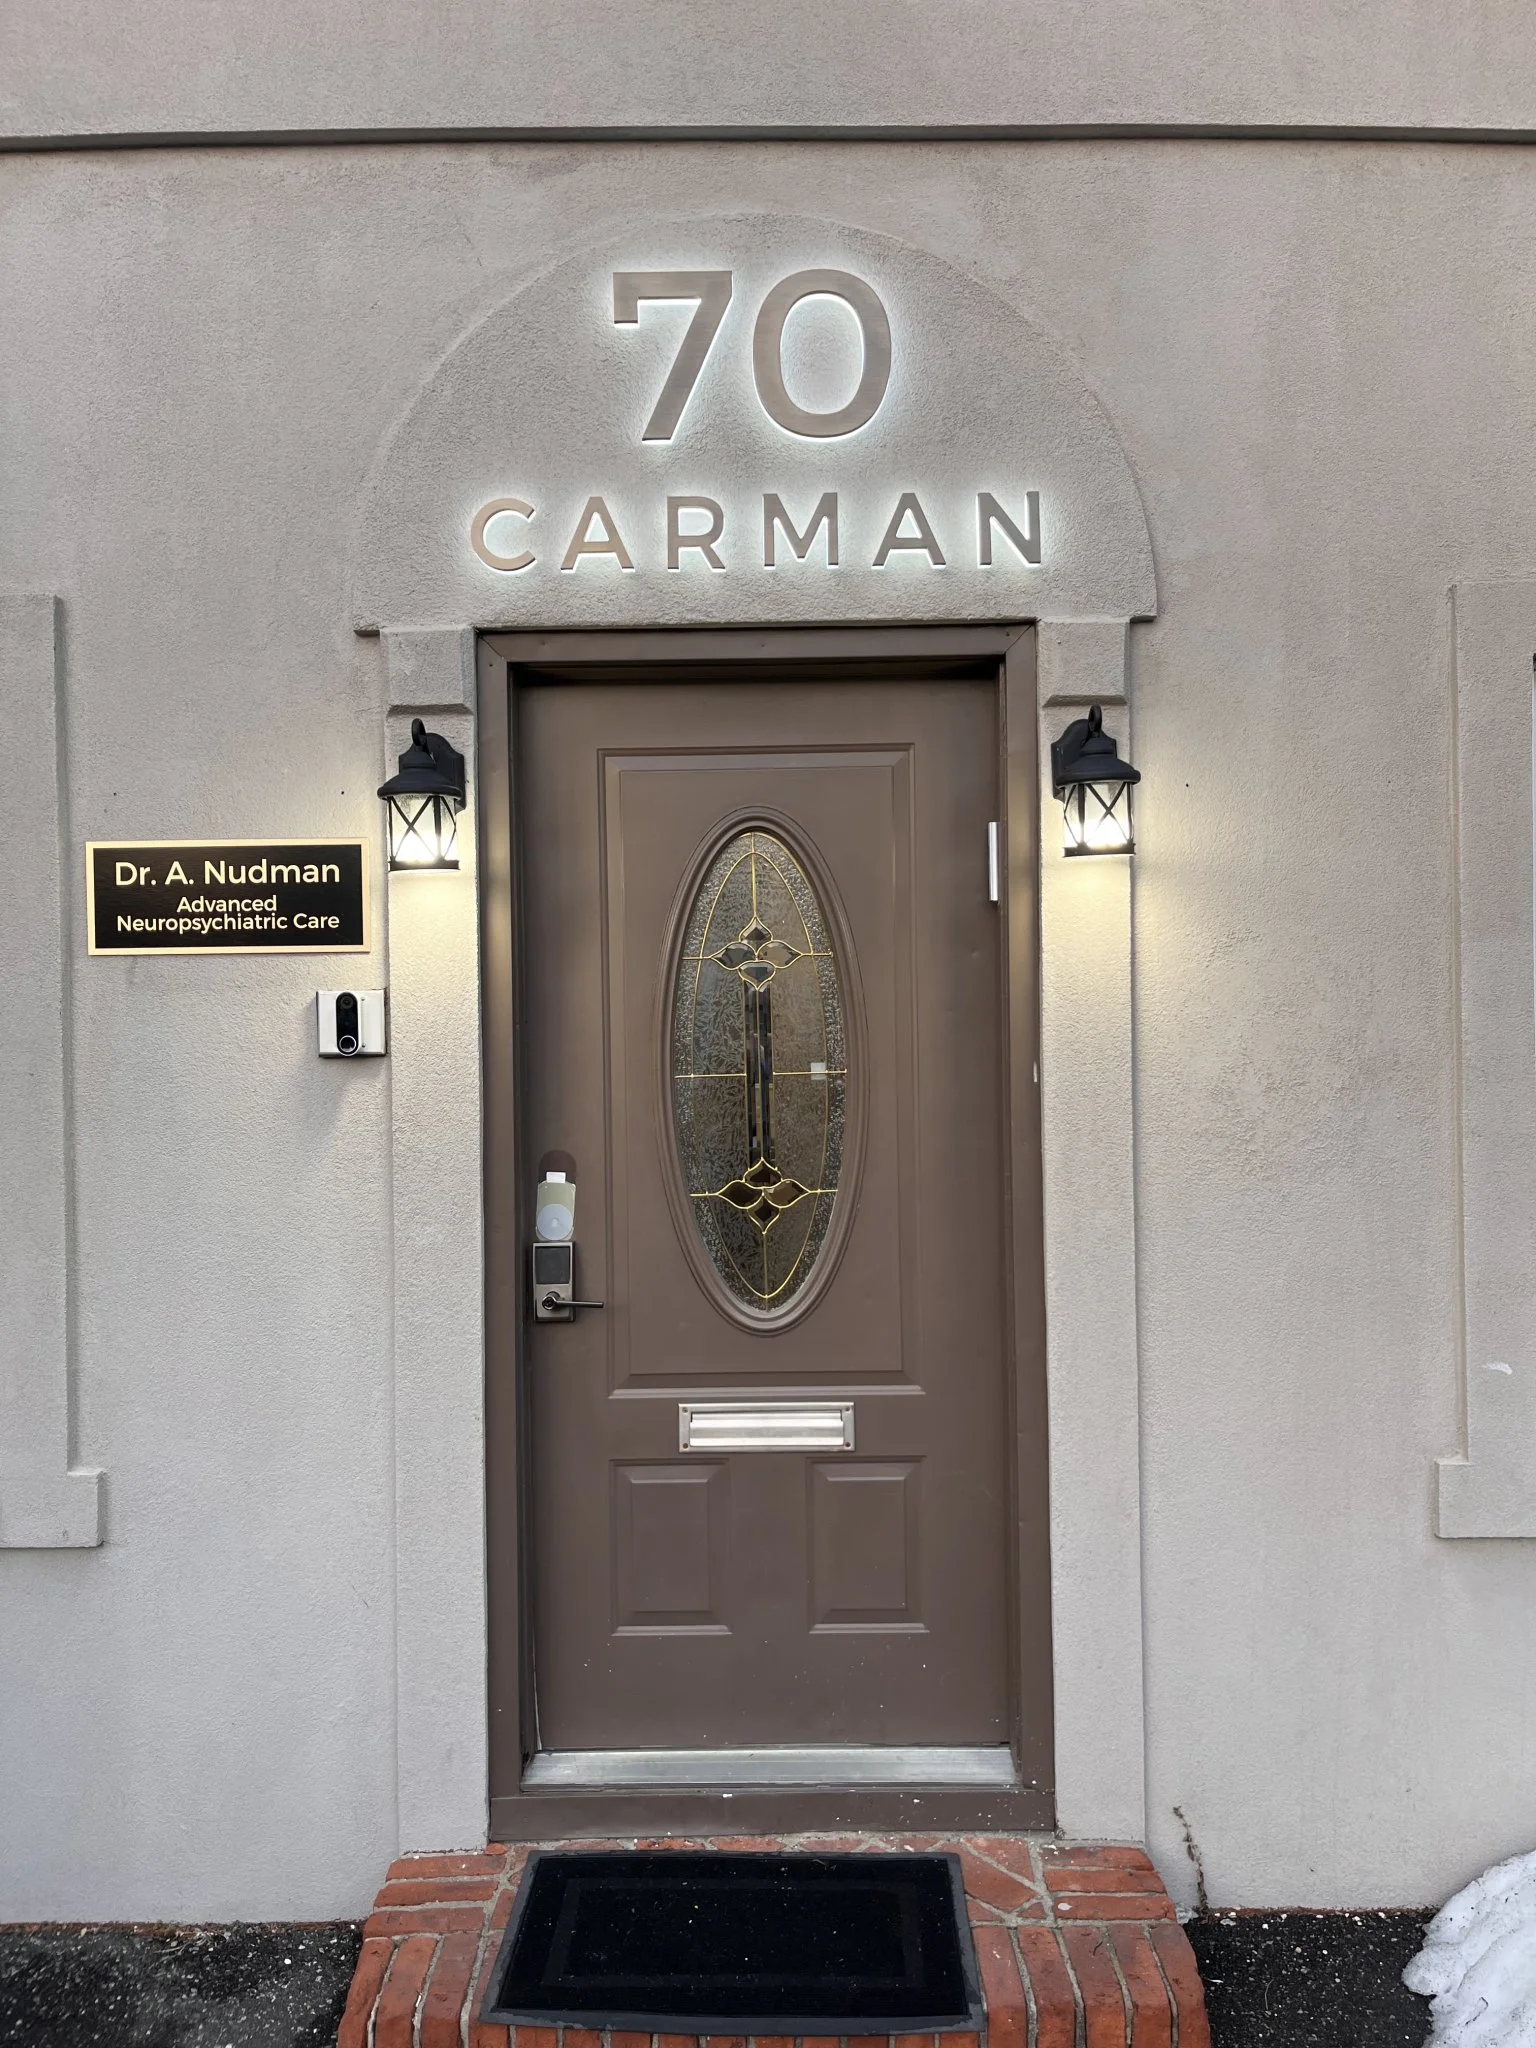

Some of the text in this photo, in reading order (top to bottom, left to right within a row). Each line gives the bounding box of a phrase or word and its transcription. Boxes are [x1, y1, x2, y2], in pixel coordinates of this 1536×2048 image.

[612, 268, 892, 442] 70
[469, 490, 1042, 572] CARMAN
[115, 858, 340, 886] Dr. A. Nudman
[176, 894, 278, 913] Advanced
[116, 913, 340, 934] Neuropsychiatric Care
